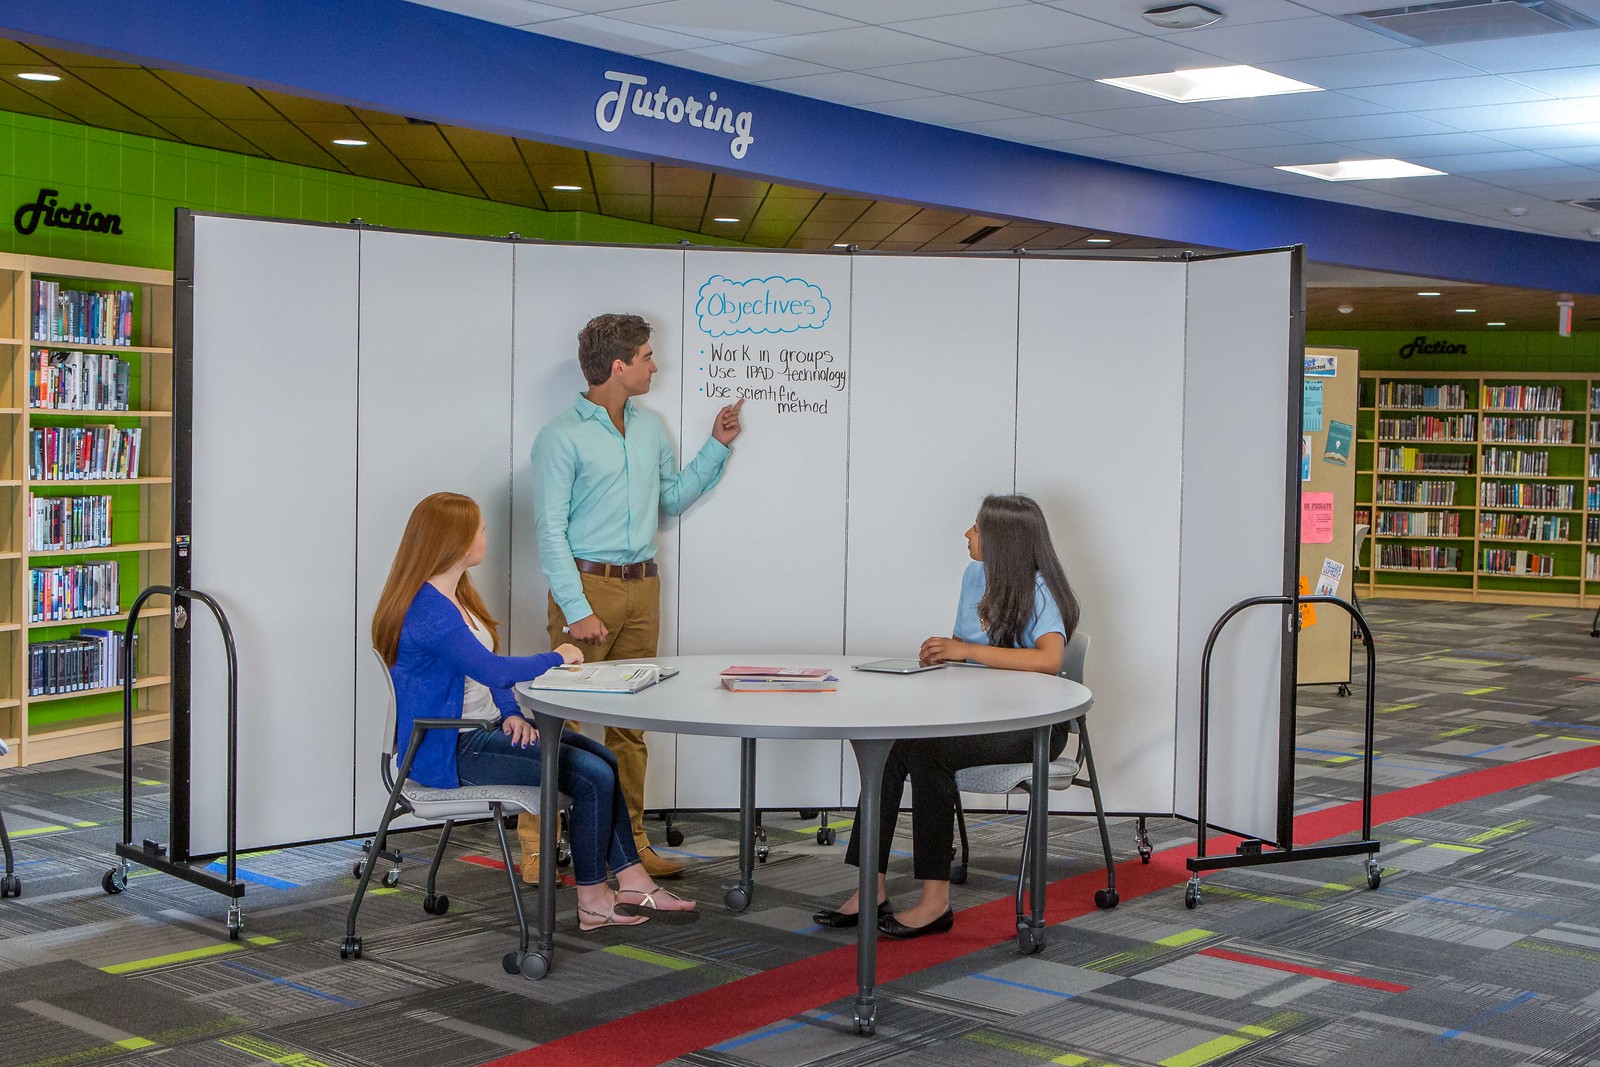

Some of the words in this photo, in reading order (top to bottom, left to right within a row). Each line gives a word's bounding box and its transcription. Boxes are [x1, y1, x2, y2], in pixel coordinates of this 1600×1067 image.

[595, 70, 754, 160] Tutoring
[14, 188, 123, 235] Fiction
[707, 289, 816, 324] Objectives
[711, 343, 751, 362] Work
[759, 347, 770, 363] in
[777, 348, 834, 374] groups
[1399, 335, 1468, 359] Fiction
[705, 382, 731, 399] Use
[736, 385, 799, 402] scientific
[708, 363, 737, 379] Use
[746, 365, 774, 380] IPAD
[785, 367, 846, 392] technology
[777, 399, 828, 414] method
